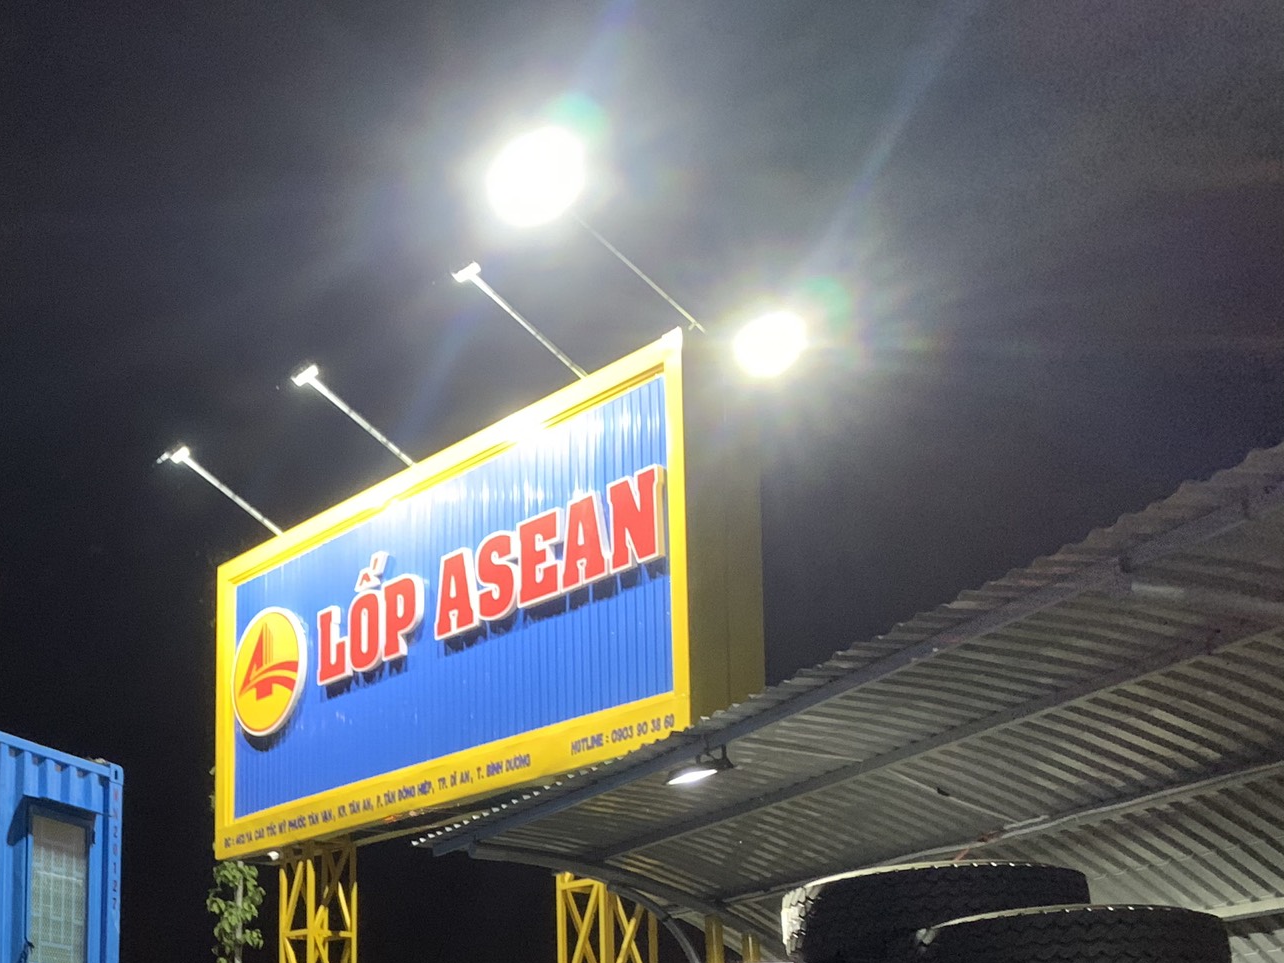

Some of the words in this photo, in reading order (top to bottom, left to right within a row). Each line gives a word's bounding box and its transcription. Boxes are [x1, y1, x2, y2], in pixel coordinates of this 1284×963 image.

[317, 551, 422, 686] LỐP
[434, 464, 664, 640] ASEAN
[571, 733, 604, 755] HOTLINE
